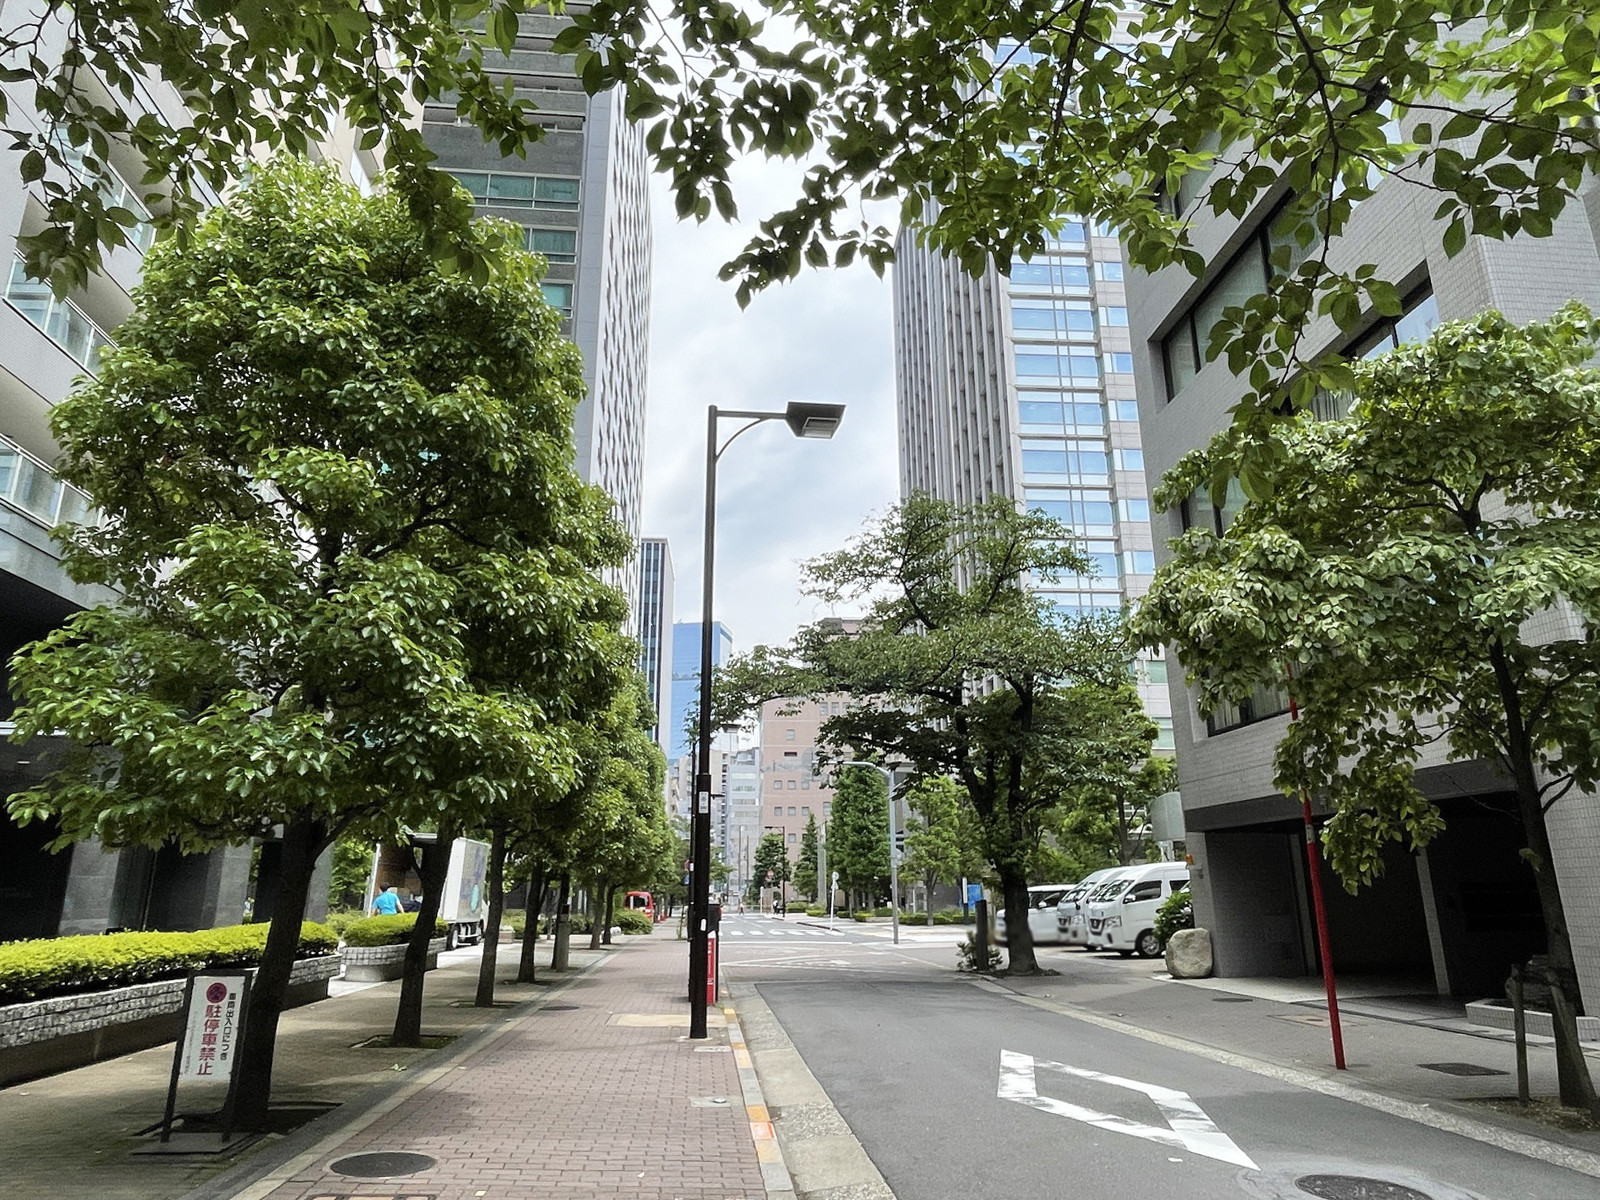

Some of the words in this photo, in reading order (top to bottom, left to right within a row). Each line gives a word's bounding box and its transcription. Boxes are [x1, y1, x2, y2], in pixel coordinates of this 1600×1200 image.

[196, 1004, 222, 1076] 駐停車禁止
